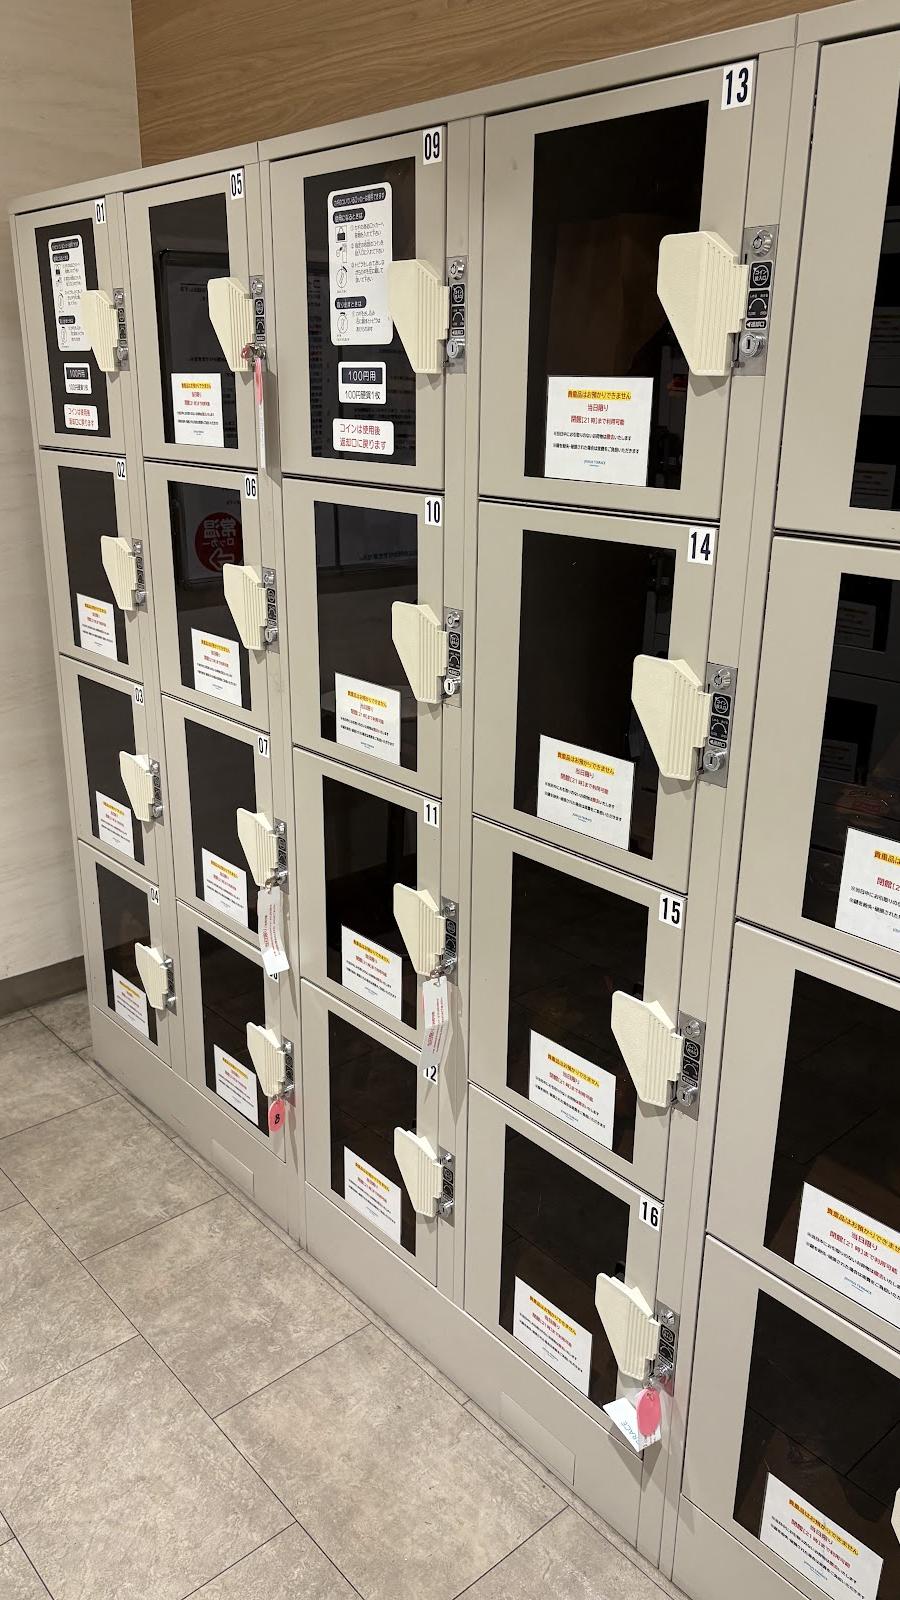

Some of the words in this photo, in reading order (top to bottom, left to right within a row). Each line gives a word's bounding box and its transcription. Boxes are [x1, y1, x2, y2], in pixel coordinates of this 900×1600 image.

[725, 67, 749, 106] 13
[424, 131, 440, 161] 09
[231, 173, 243, 197] 05
[96, 203, 105, 223] 01
[348, 370, 376, 381] 100円用
[344, 390, 381, 400] 100円硬貨1枚
[567, 390, 632, 400] 貴重品はお預かりできません
[587, 403, 609, 412] 当日限り
[340, 423, 381, 435] コインは使用後
[340, 437, 387, 450] 返却口に戻ります
[117, 461, 126, 478] 02
[245, 477, 257, 497] 06
[426, 500, 441, 524] 10
[691, 531, 711, 561] 14
[135, 687, 144, 704] 03
[258, 737, 268, 756] 07
[426, 803, 437, 825] 11
[150, 887, 159, 904] 04
[662, 897, 680, 925] 15
[642, 1201, 659, 1227] 16
[851, 1231, 878, 1251] 当日限り
